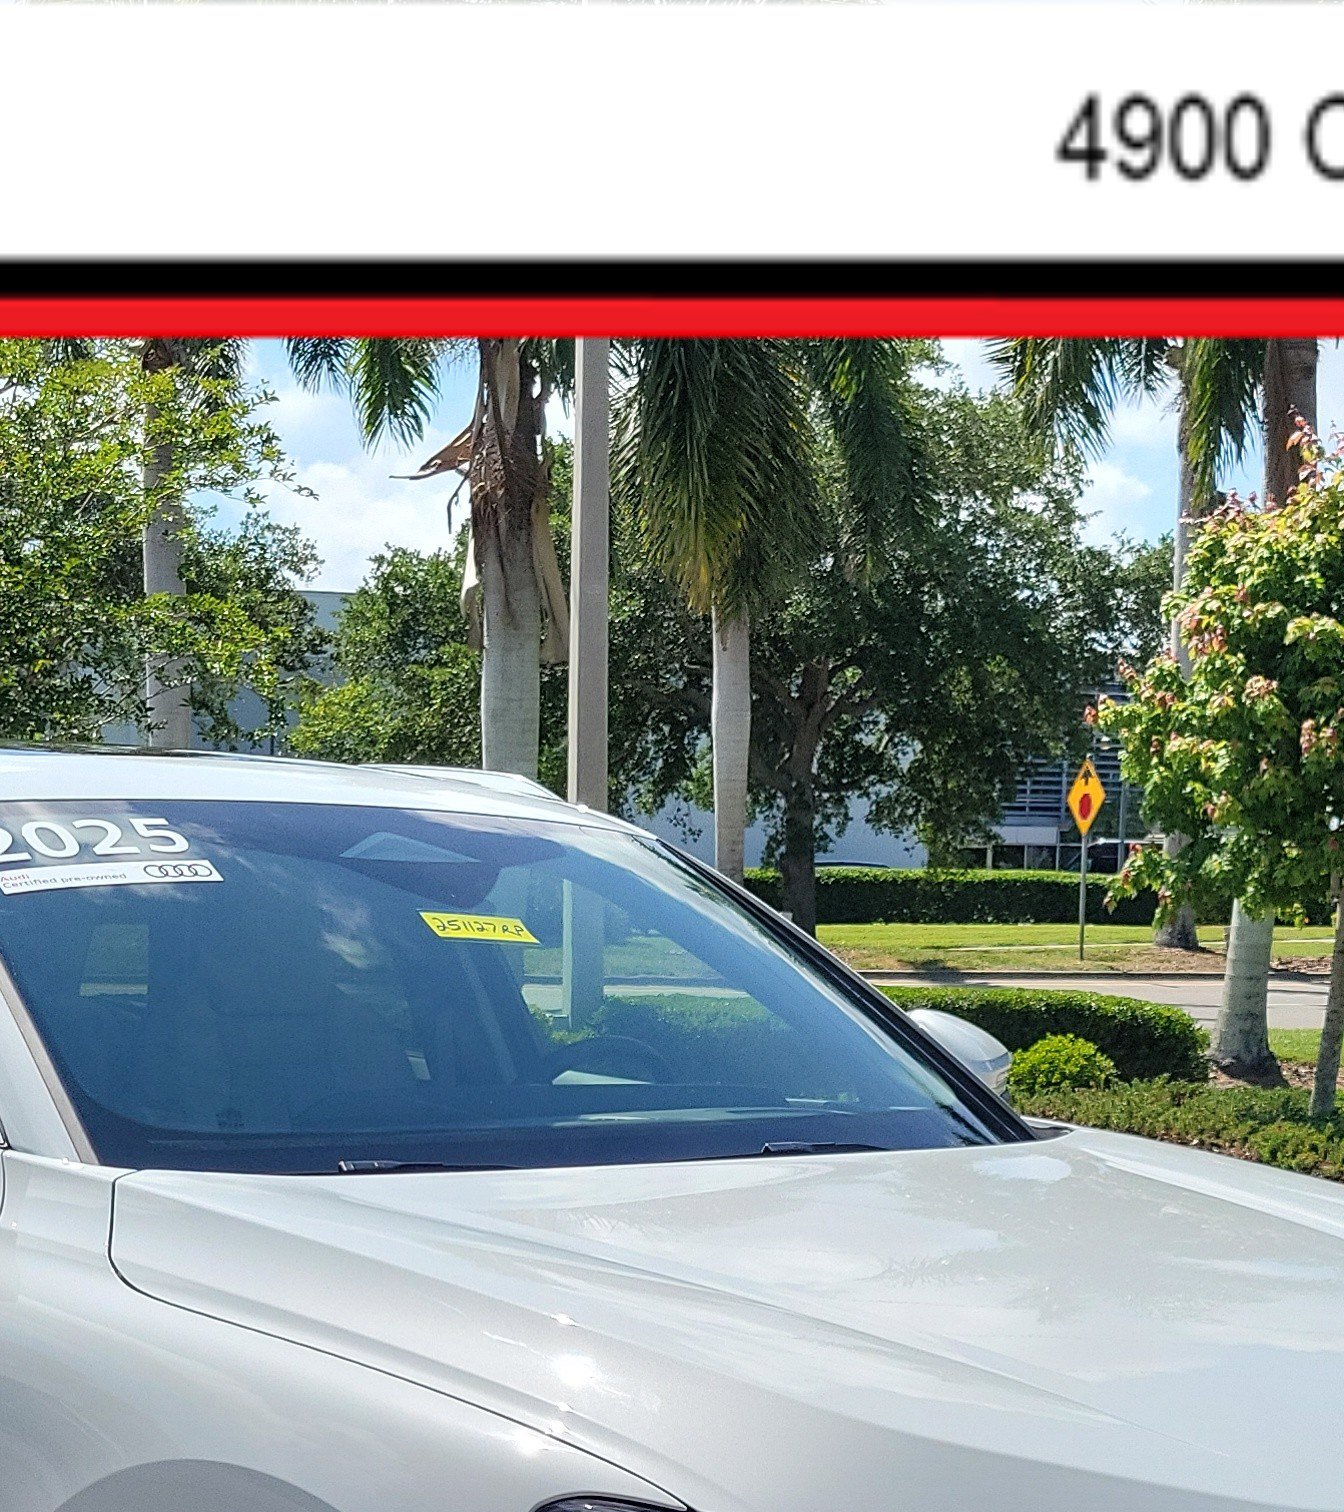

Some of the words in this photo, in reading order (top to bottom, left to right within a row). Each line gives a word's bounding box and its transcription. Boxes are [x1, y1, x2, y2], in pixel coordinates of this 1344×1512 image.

[0, 873, 30, 883] Audi
[2, 876, 57, 890] Certified
[60, 873, 127, 884] pre-owned
